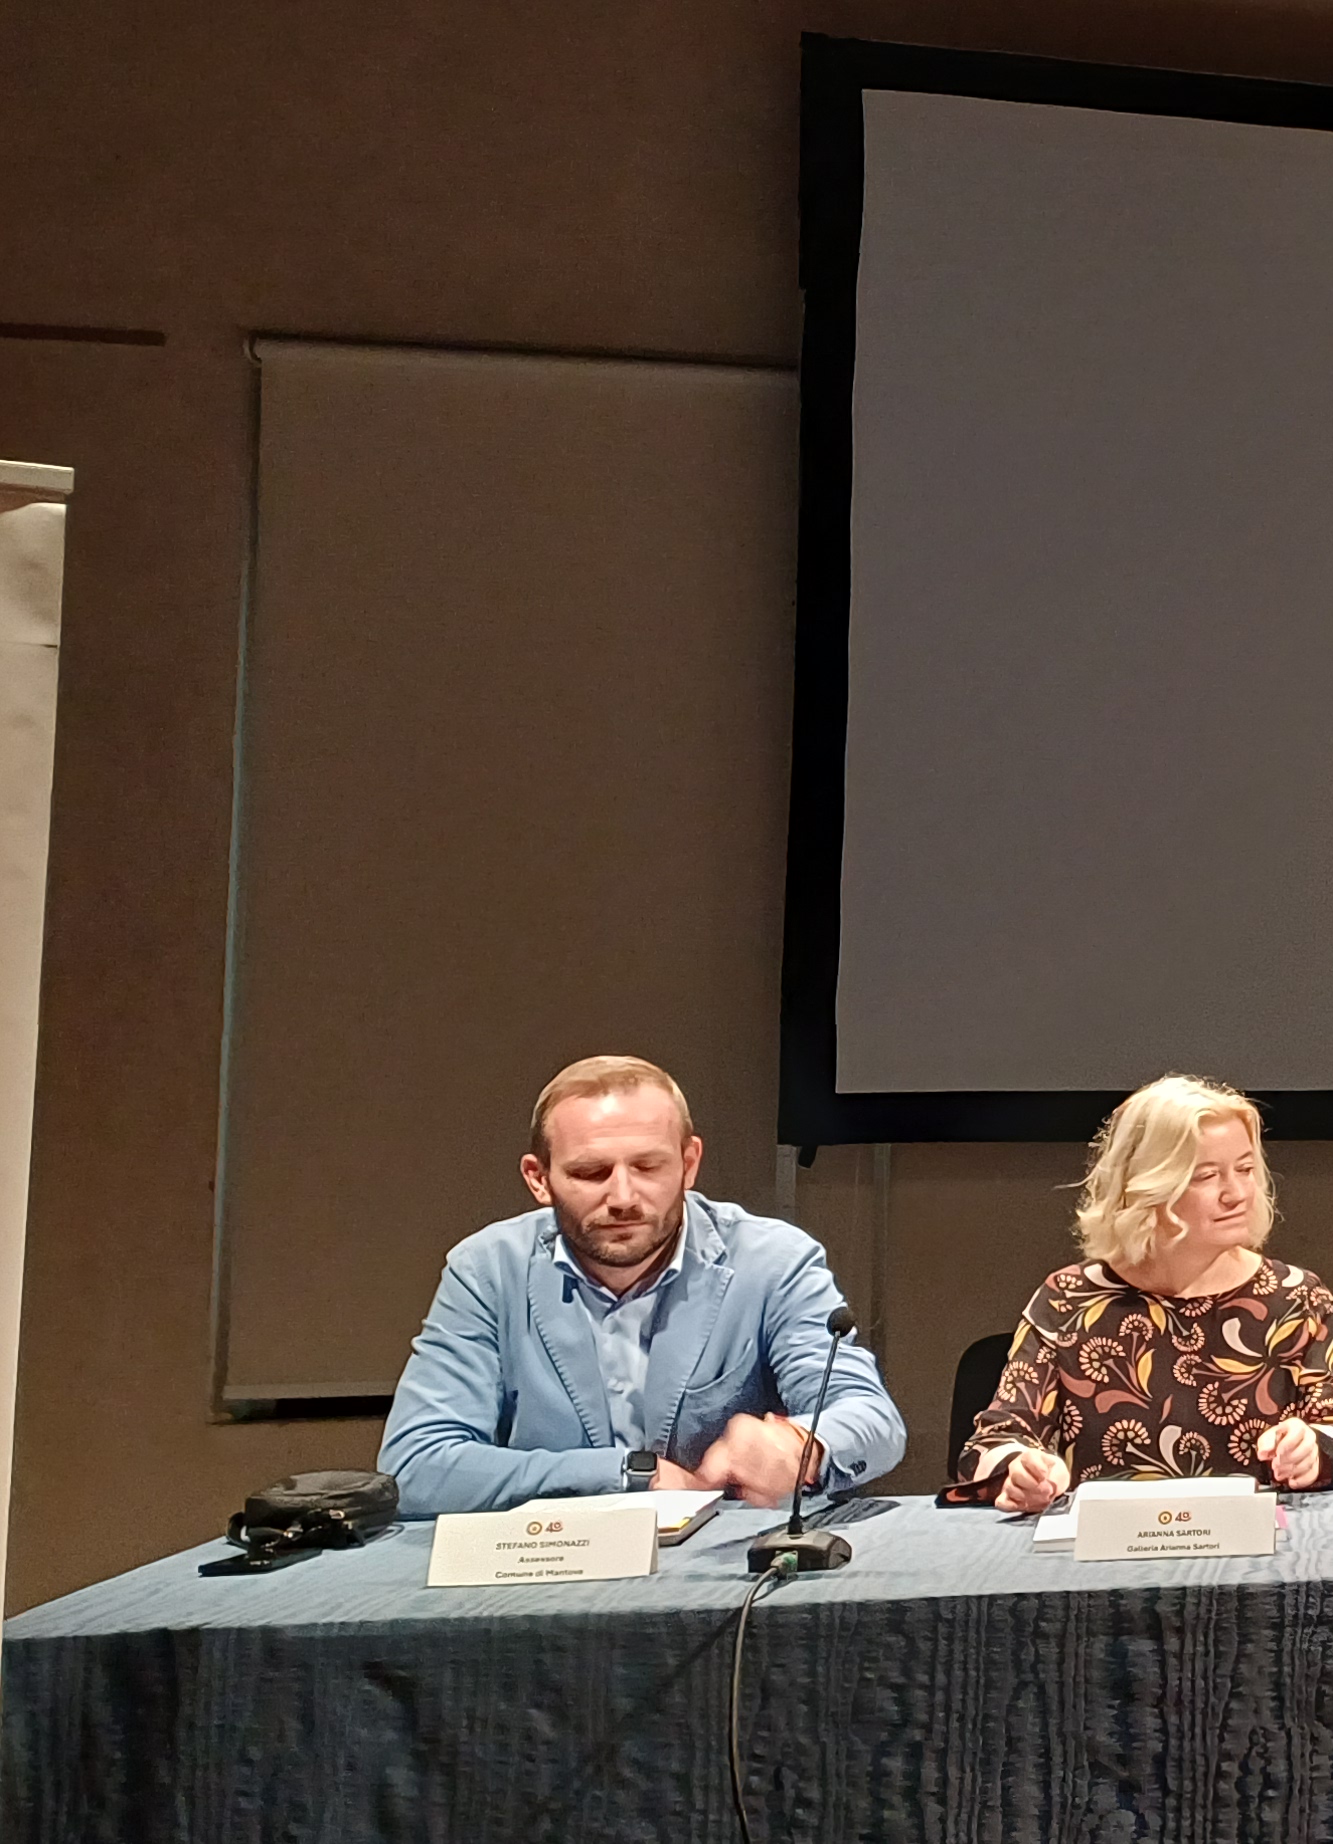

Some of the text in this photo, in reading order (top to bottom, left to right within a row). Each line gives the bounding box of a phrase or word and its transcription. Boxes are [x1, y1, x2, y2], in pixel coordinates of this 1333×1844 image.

[1137, 1529, 1211, 1538] ARIANNA SARTORI
[496, 1540, 589, 1550] STEFANO SIMONAZZI
[1127, 1542, 1220, 1552] Galleria Arianna Sartori
[517, 1555, 564, 1564] Assessore
[495, 1570, 533, 1578] Comune
[546, 1568, 583, 1576] Mantova
